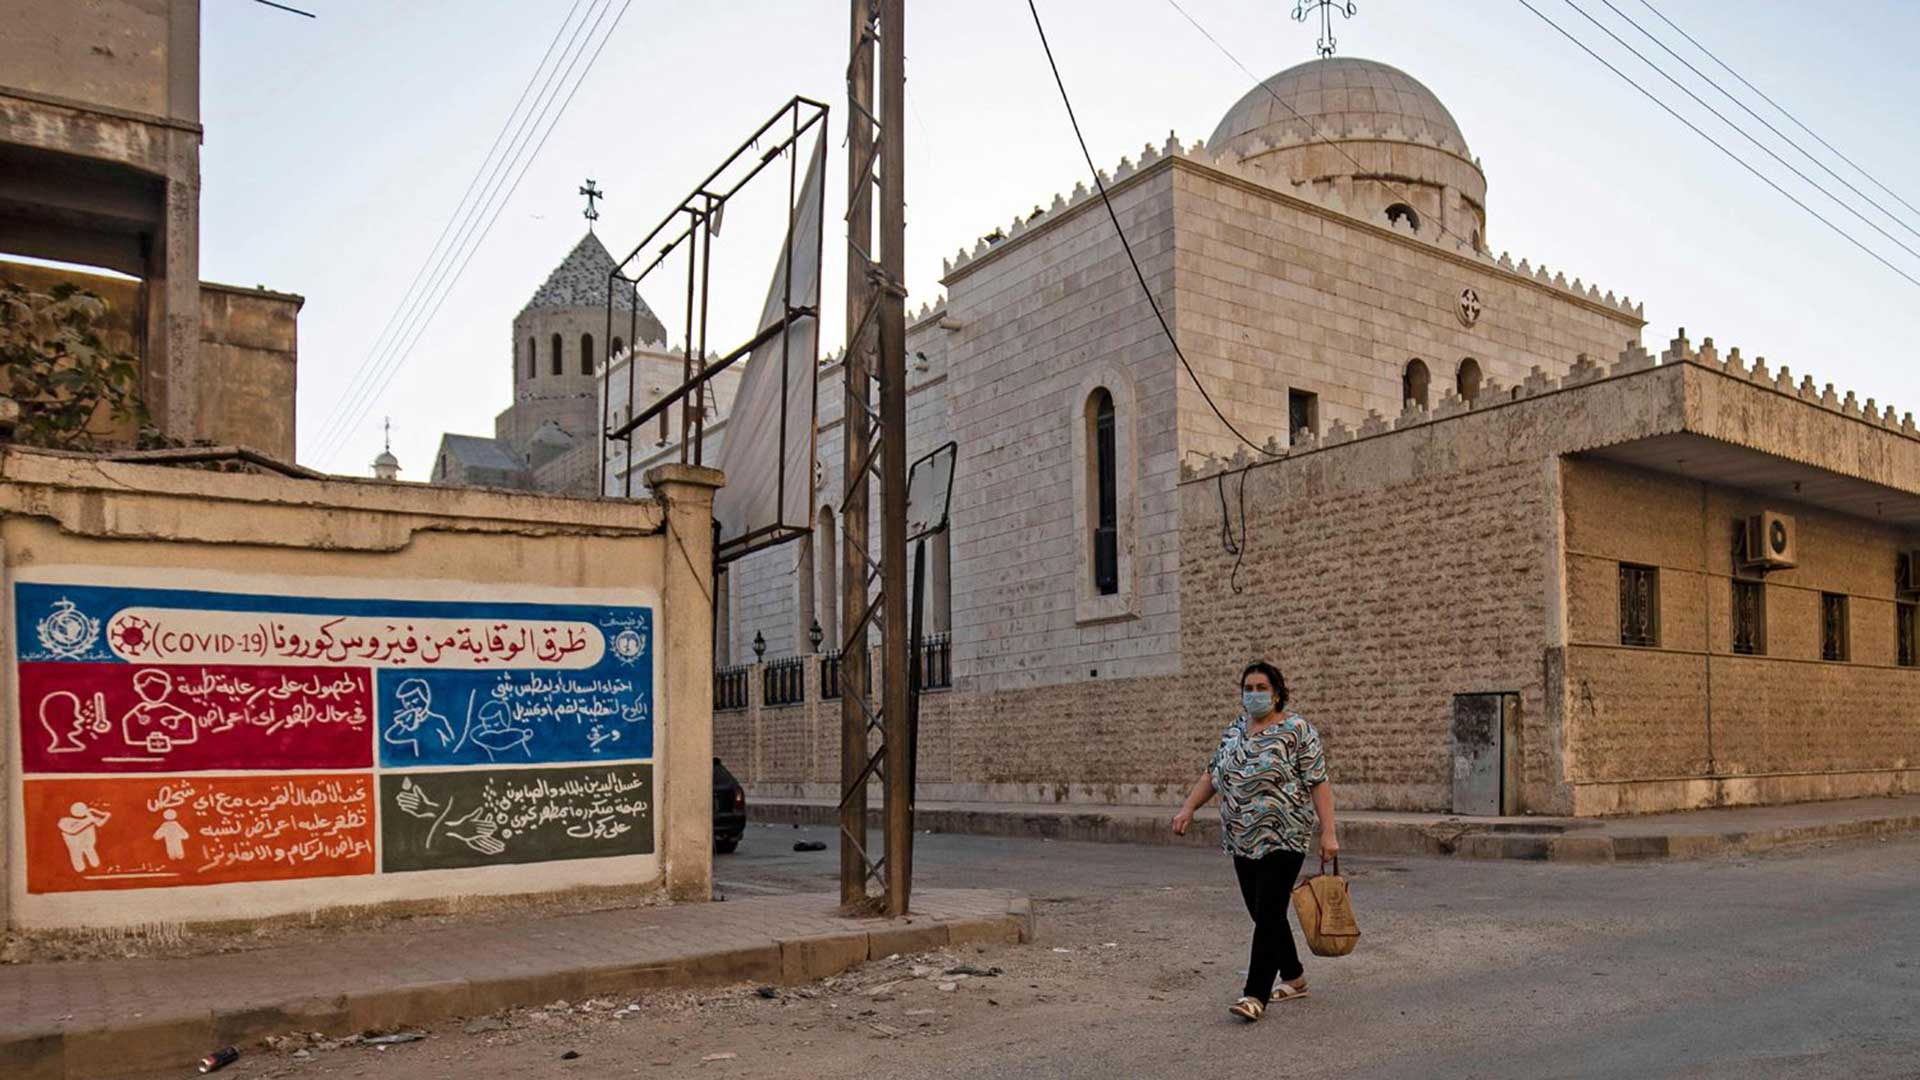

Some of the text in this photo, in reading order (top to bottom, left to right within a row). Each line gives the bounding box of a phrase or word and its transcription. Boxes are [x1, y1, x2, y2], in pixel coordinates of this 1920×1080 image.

[152, 622, 268, 658] (COVID-19)
[271, 617, 347, 658] كورونا
[421, 635, 455, 663] من
[458, 623, 535, 662] الوقاية
[177, 668, 365, 706] الحصول على رعاية طبية
[563, 680, 601, 693] السعال
[601, 678, 633, 693] احتواء
[316, 704, 349, 723] حال
[347, 700, 367, 731] في
[621, 692, 648, 722] الكوع
[147, 779, 196, 812] شخص
[290, 779, 341, 806] الاتصال
[339, 779, 367, 810] تجنب
[584, 772, 616, 798] اليدين
[614, 772, 642, 793] غسل
[215, 792, 243, 815] مع
[245, 781, 293, 818] القريب
[615, 798, 647, 817] بصفة
[199, 813, 243, 842] تشبه
[299, 813, 331, 837] عليه
[603, 821, 632, 838] على
[287, 839, 330, 865] الزكام
